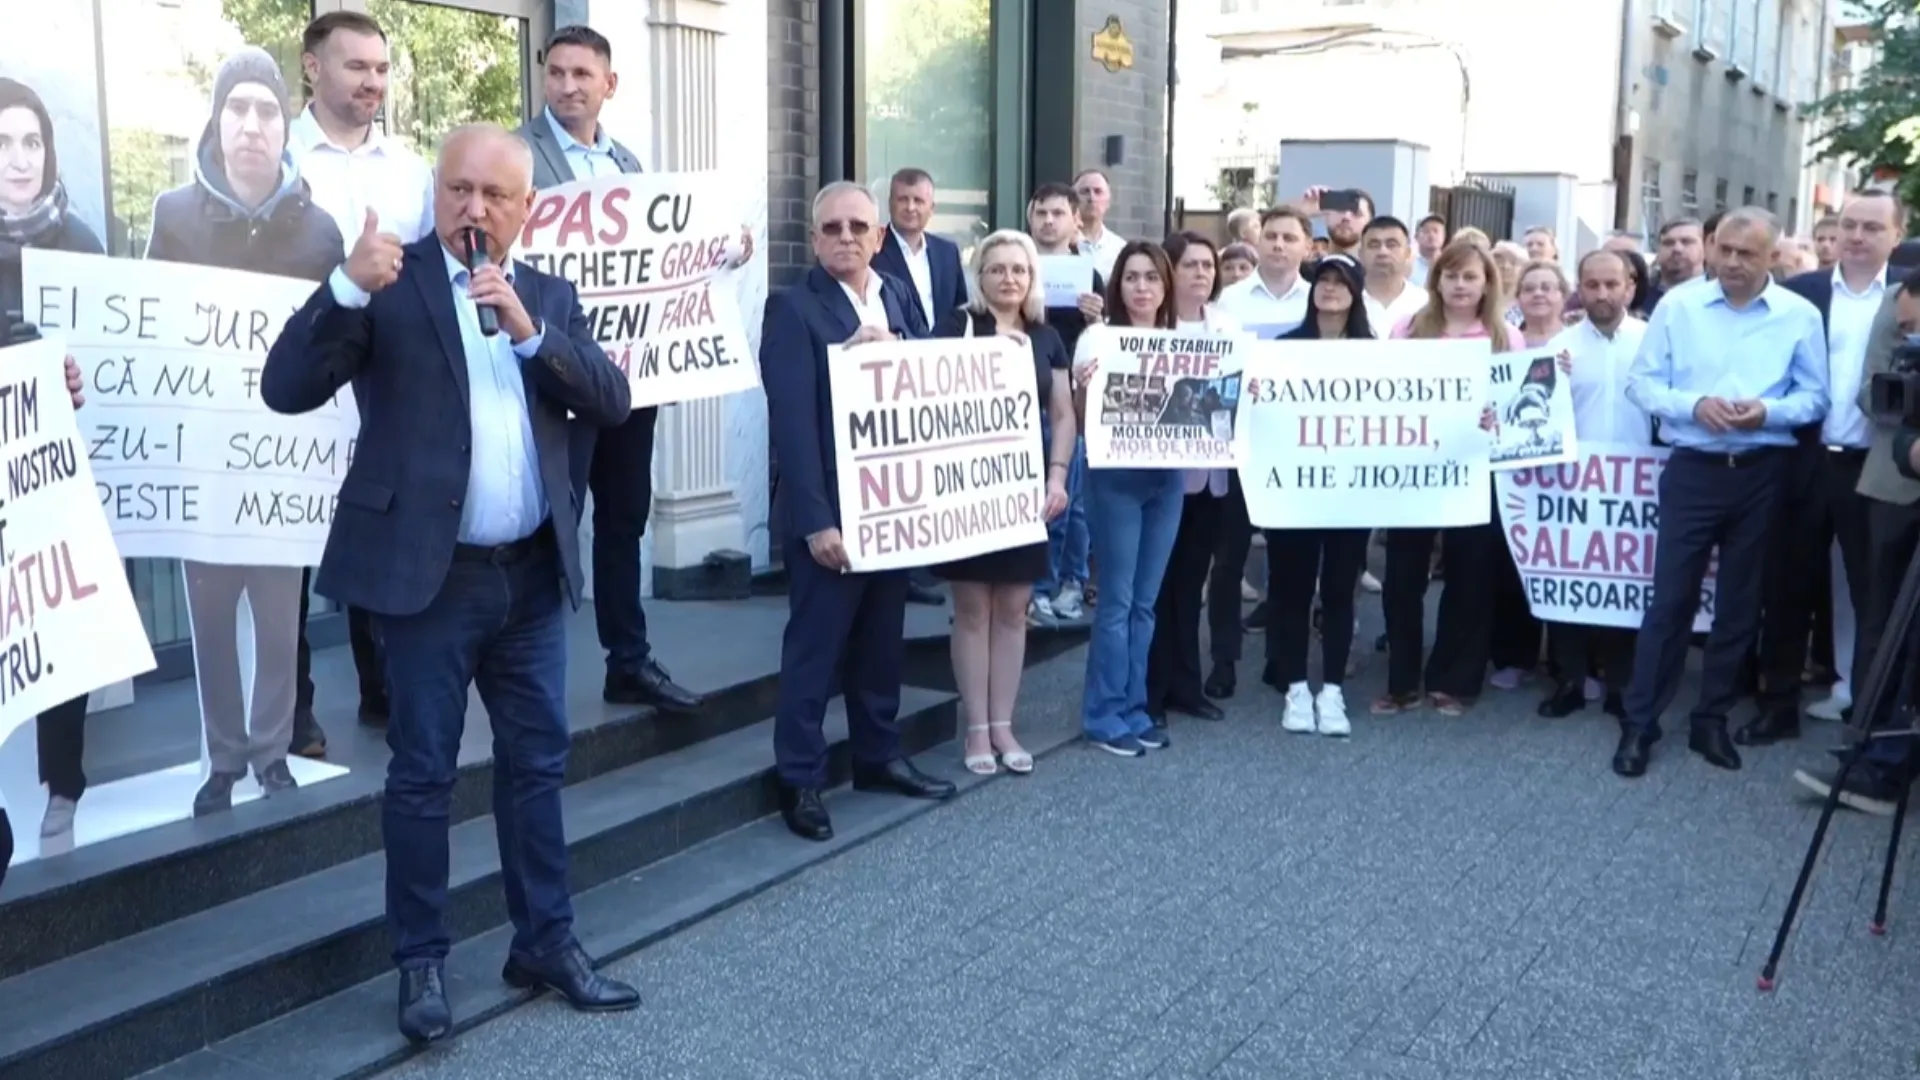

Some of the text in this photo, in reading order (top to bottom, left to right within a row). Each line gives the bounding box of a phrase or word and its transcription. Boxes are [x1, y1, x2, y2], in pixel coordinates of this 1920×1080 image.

[520, 187, 692, 249] PAS CU
[660, 233, 730, 280] GRASE,
[39, 286, 77, 329] EI
[103, 296, 160, 339] SE
[658, 281, 715, 334] FĂRĂ
[667, 335, 739, 373] CASE.
[1119, 335, 1144, 353] VOI
[1147, 336, 1167, 352] NE
[94, 356, 138, 396] CĂ
[153, 364, 214, 398] NU
[860, 351, 1006, 403] TALOANE
[1260, 377, 1473, 403] ЗАМОРОЗЬТЕ
[849, 391, 1032, 450] MILIONARILOR?
[1111, 425, 1203, 440] MOLDOVENII
[1297, 414, 1440, 453] ЦЕНЫ,
[8, 437, 77, 502] NOSTRU
[858, 450, 1038, 511] NU DIN CONTUL
[1265, 459, 1470, 490] А НЕ ЛЮДЕЙ!
[858, 487, 1039, 558] PENSIONARILOR!
[1536, 493, 1588, 526] DIN
